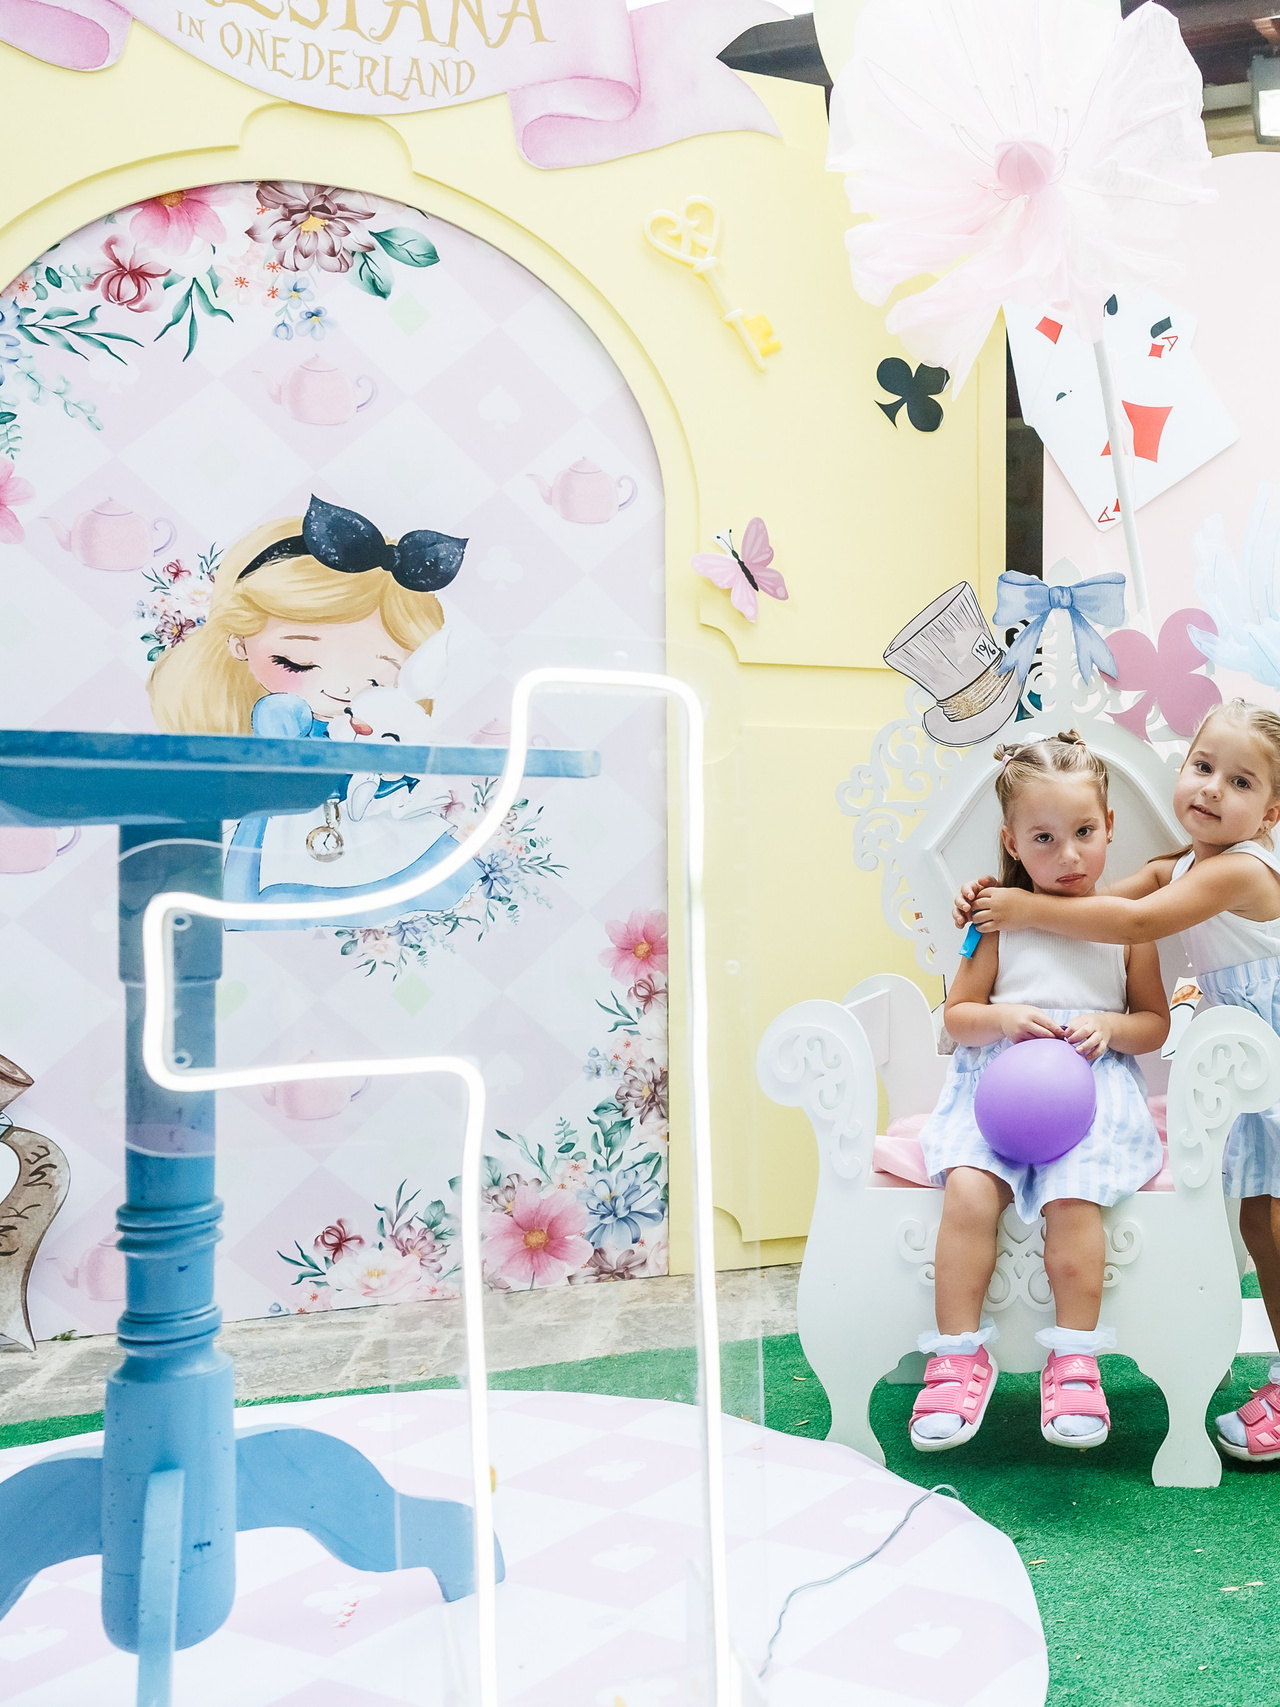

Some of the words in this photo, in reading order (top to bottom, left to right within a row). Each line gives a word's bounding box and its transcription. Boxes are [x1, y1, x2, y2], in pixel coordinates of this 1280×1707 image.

[176, 10, 207, 43] IN
[219, 20, 476, 101] ONEDERLAND
[974, 639, 997, 660] 10/6
[23, 1145, 58, 1190] ME
